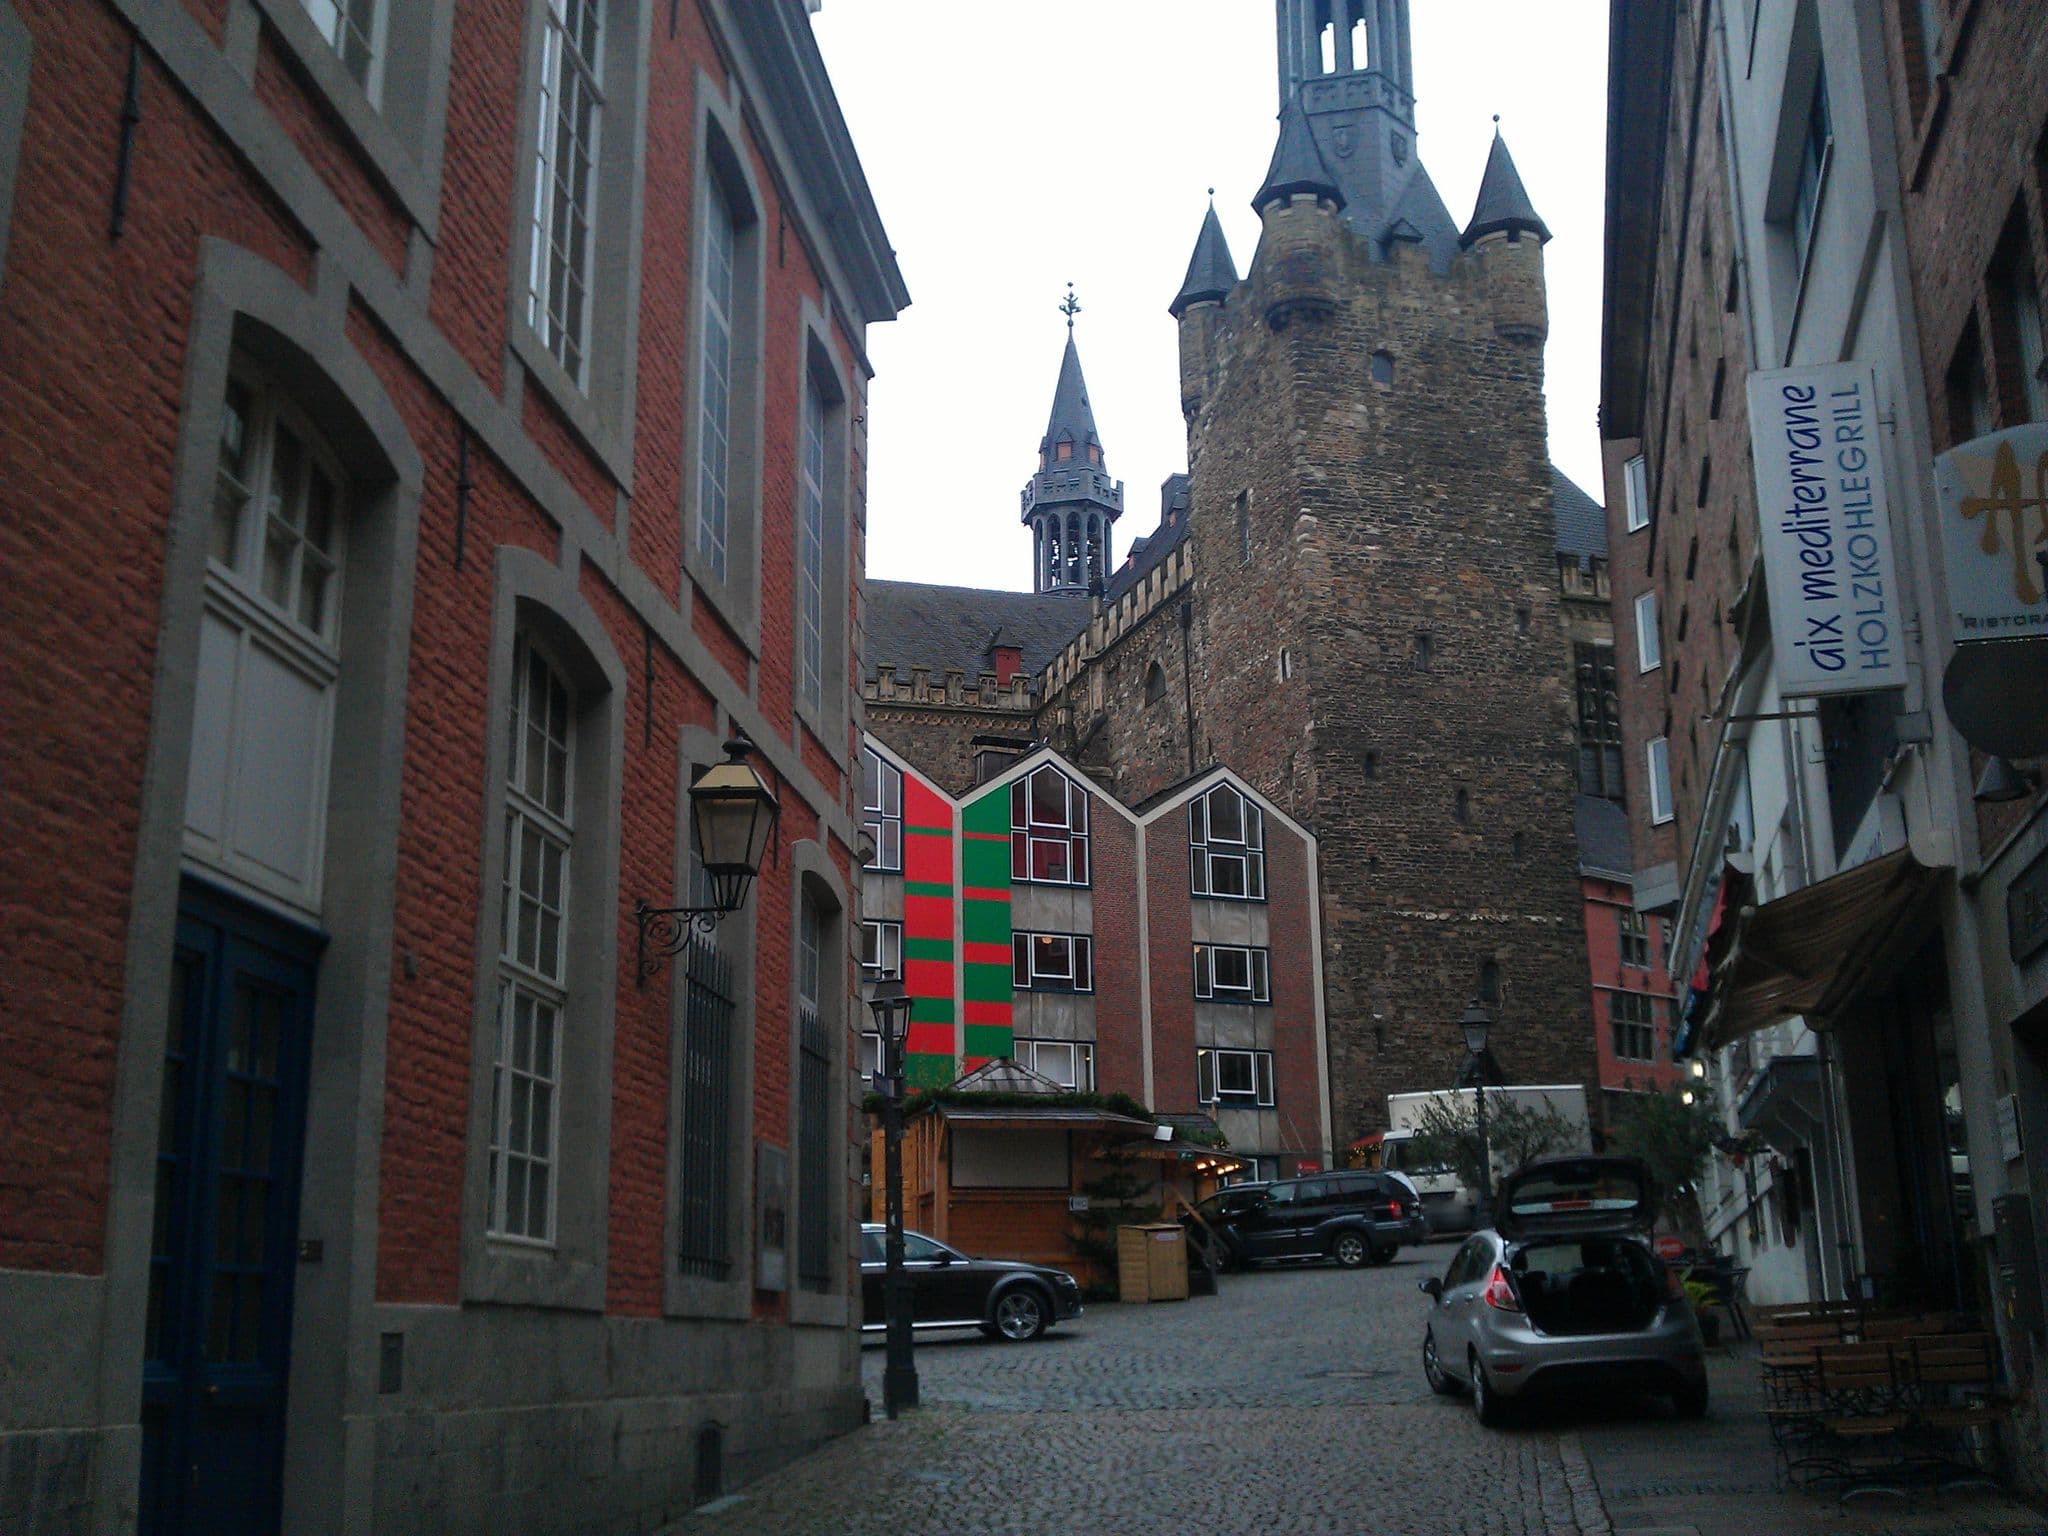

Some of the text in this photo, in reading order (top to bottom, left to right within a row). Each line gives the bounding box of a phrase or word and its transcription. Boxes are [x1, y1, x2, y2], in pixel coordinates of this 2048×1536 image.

[1781, 384, 1846, 671] aix mediterrane
[1831, 382, 1890, 671] HOLZKOHLEGRILL
